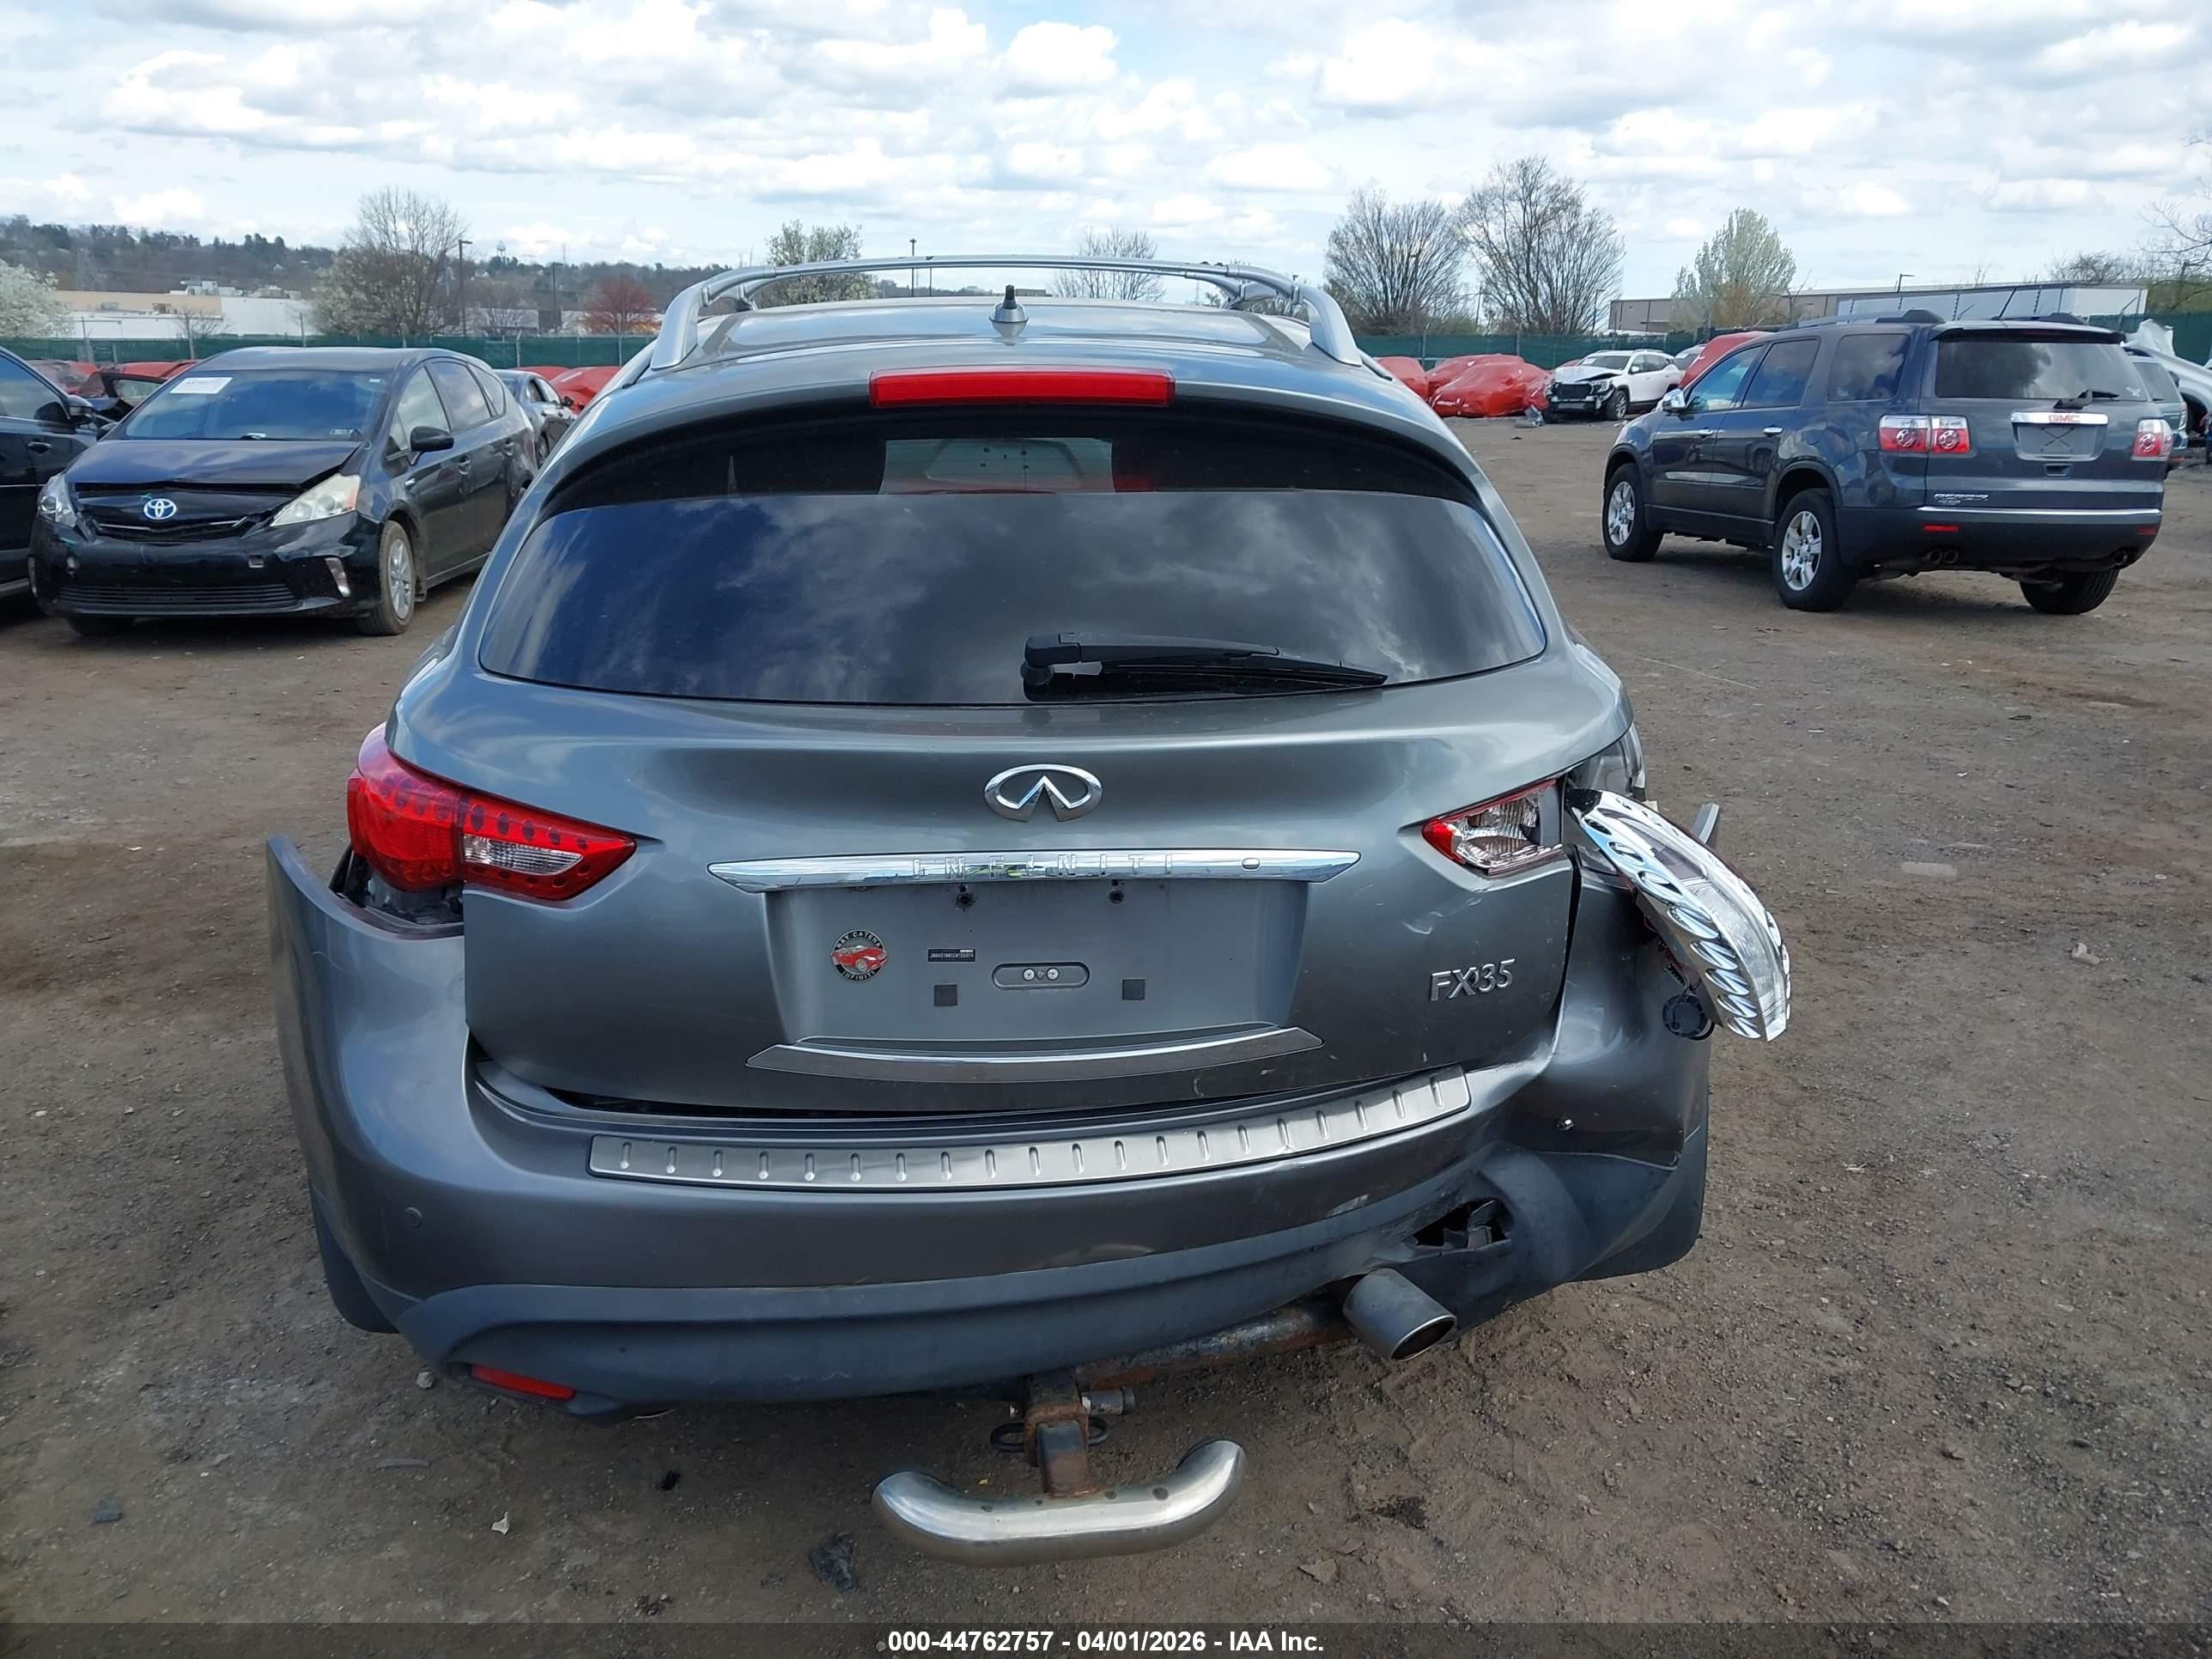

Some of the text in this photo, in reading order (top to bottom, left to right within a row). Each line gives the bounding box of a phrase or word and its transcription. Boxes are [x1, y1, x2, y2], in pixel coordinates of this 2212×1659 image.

[912, 854, 1174, 880] INFINITI
[836, 935, 849, 948] RAY
[842, 970, 875, 981] INFINITI
[1430, 957, 1516, 1001] FX35
